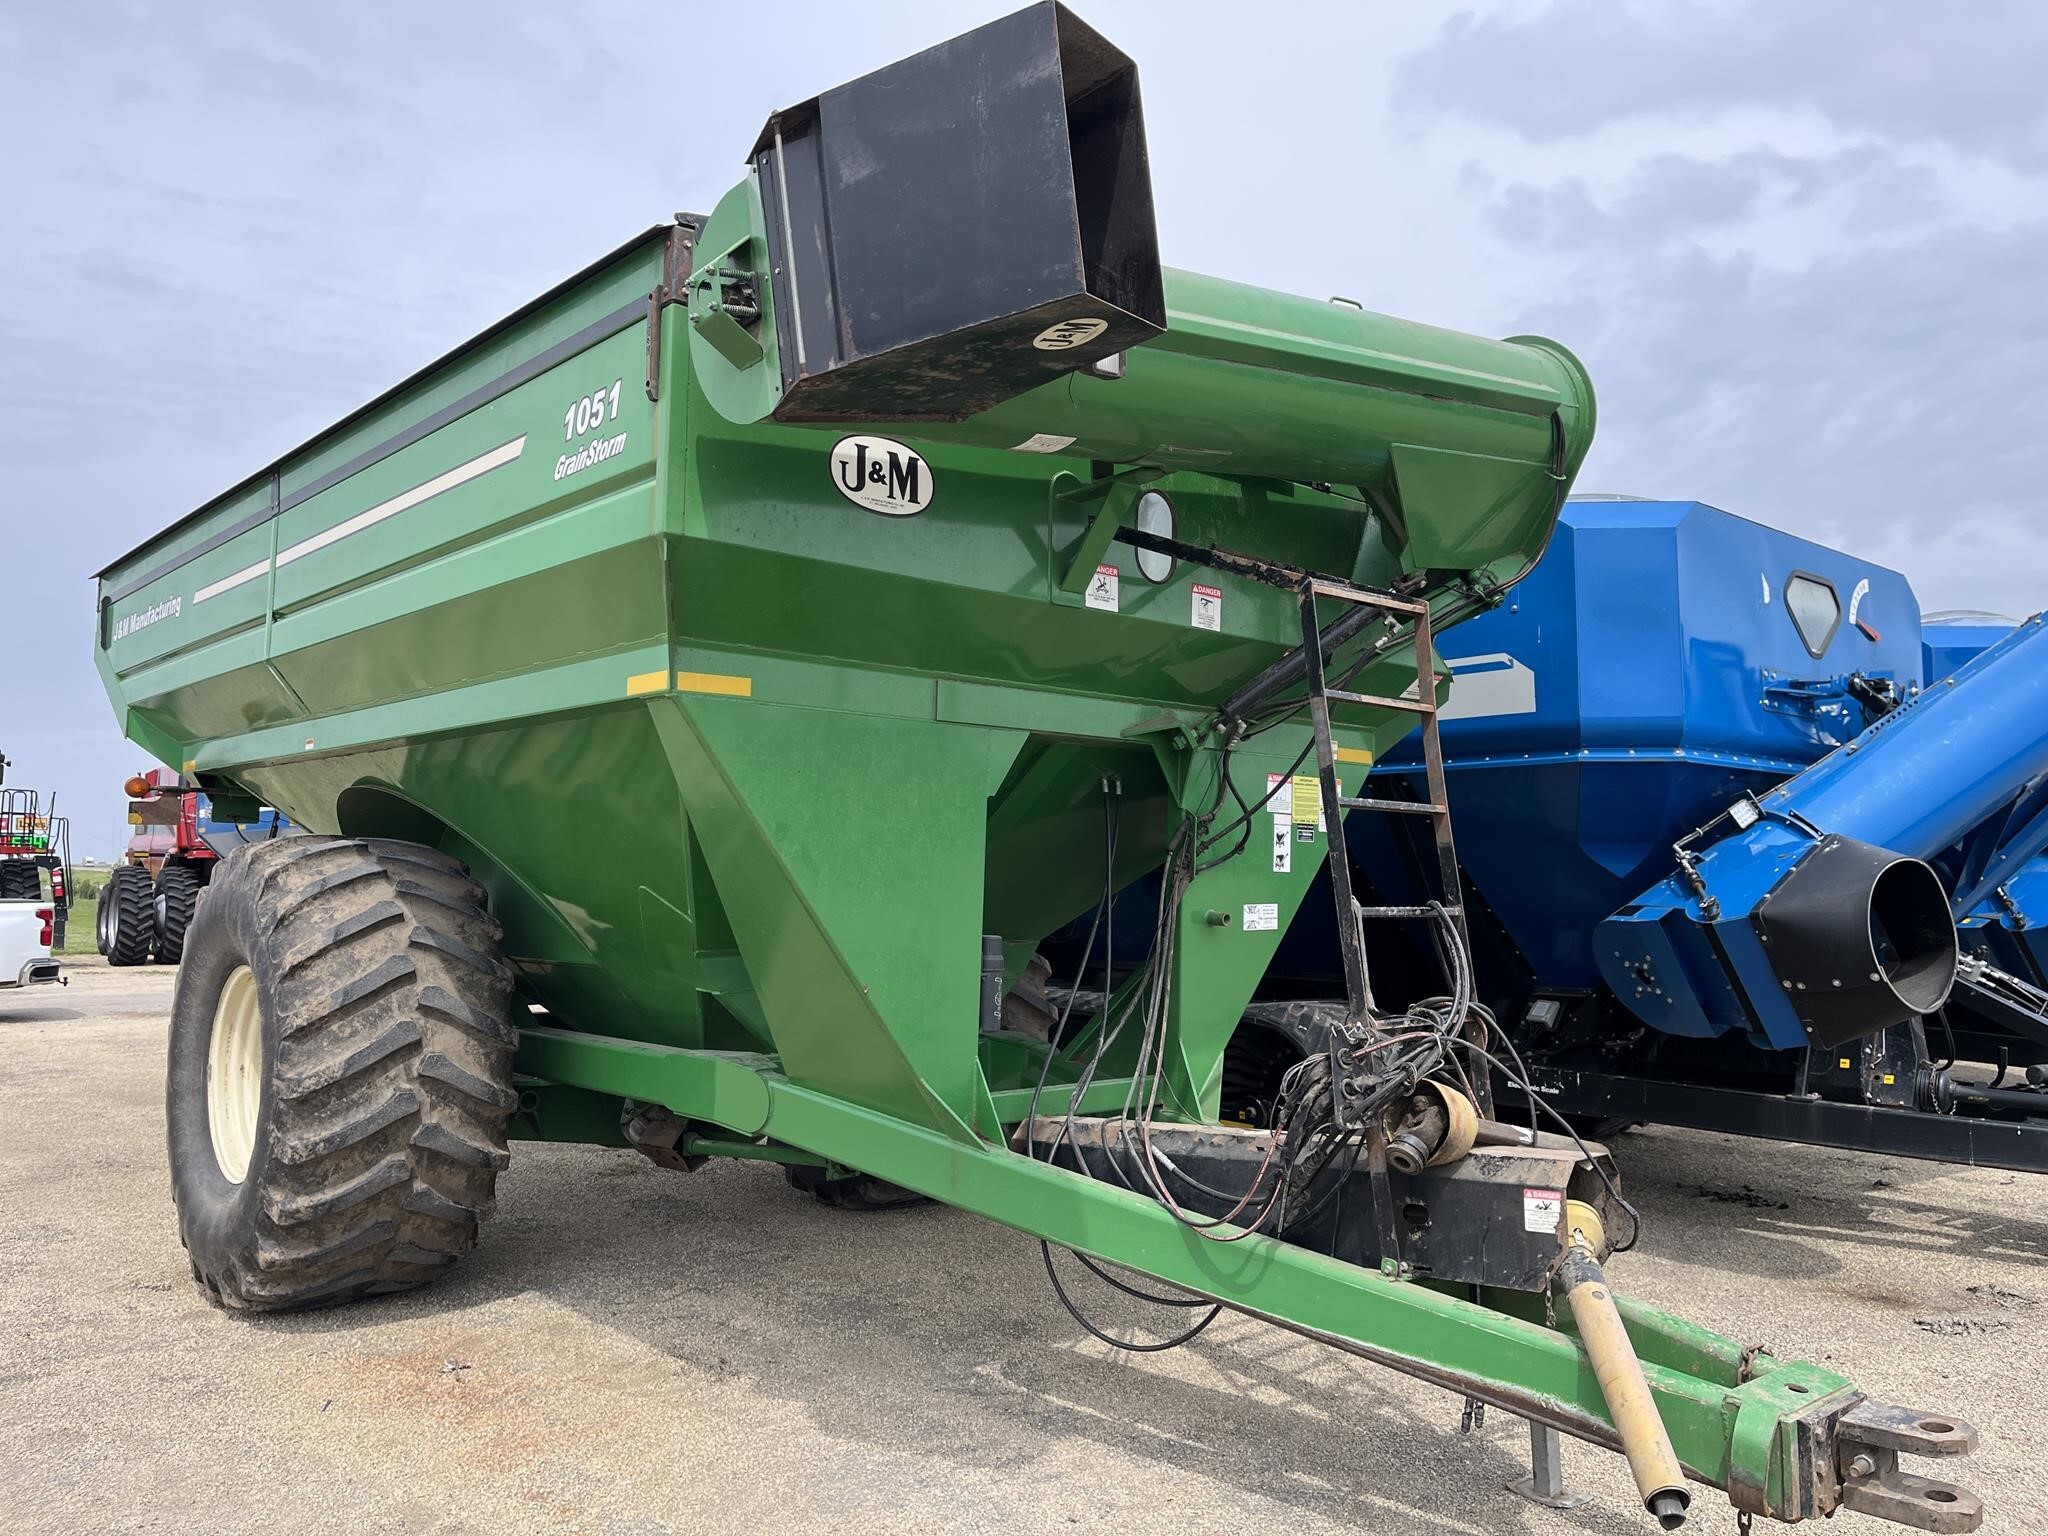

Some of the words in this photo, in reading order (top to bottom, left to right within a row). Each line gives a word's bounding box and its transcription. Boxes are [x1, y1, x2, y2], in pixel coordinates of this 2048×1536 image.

[1040, 322, 1101, 347] J&M
[563, 378, 622, 442] 1051
[554, 432, 627, 481] GrainStorm
[839, 443, 920, 504] J&M
[1096, 565, 1118, 576] ANGER
[1198, 585, 1221, 597] DANGER
[113, 617, 130, 641] J&M
[129, 596, 182, 629] Manufacturing
[1507, 1081, 1540, 1092] Elecnic
[1541, 1085, 1560, 1095] Scale
[1533, 1190, 1560, 1200] DANGER
